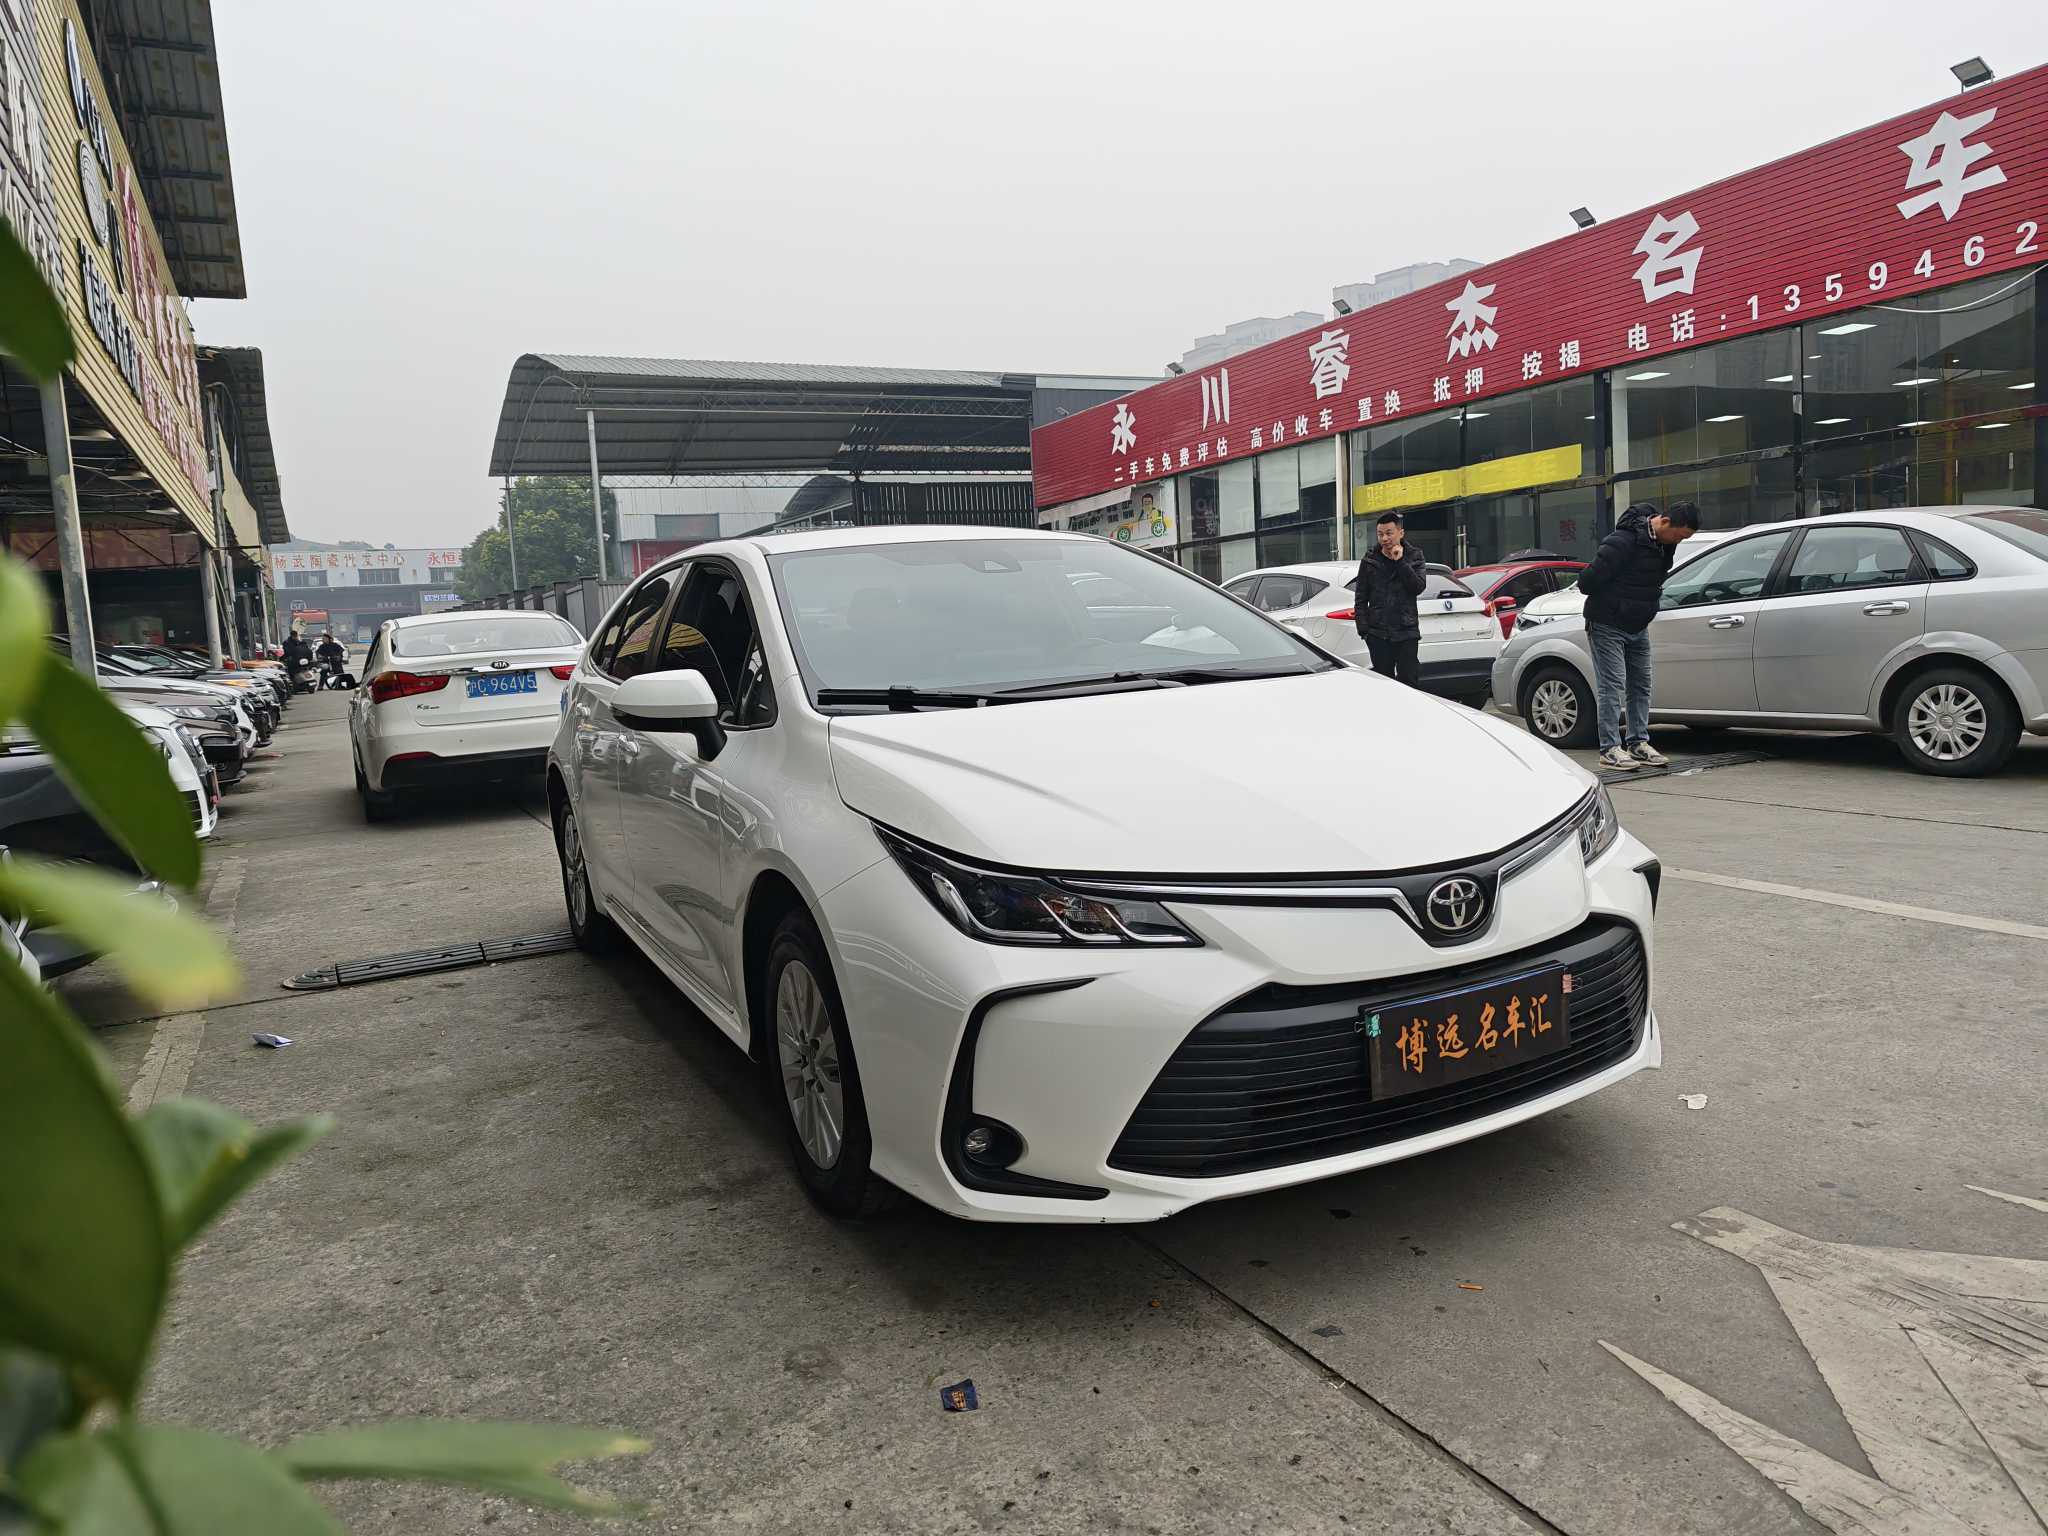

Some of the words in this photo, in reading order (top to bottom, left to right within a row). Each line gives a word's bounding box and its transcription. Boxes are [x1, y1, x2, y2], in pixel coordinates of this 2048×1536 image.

[1110, 107, 2008, 456] 永川睿杰名车
[1114, 436, 1228, 483] 二手车免费评估
[1250, 408, 1333, 450] 高价收车
[1357, 388, 1401, 423] 置换
[1433, 367, 1484, 403] 抵押
[1522, 340, 1581, 381] 按揭
[492, 661, 509, 669] KIA
